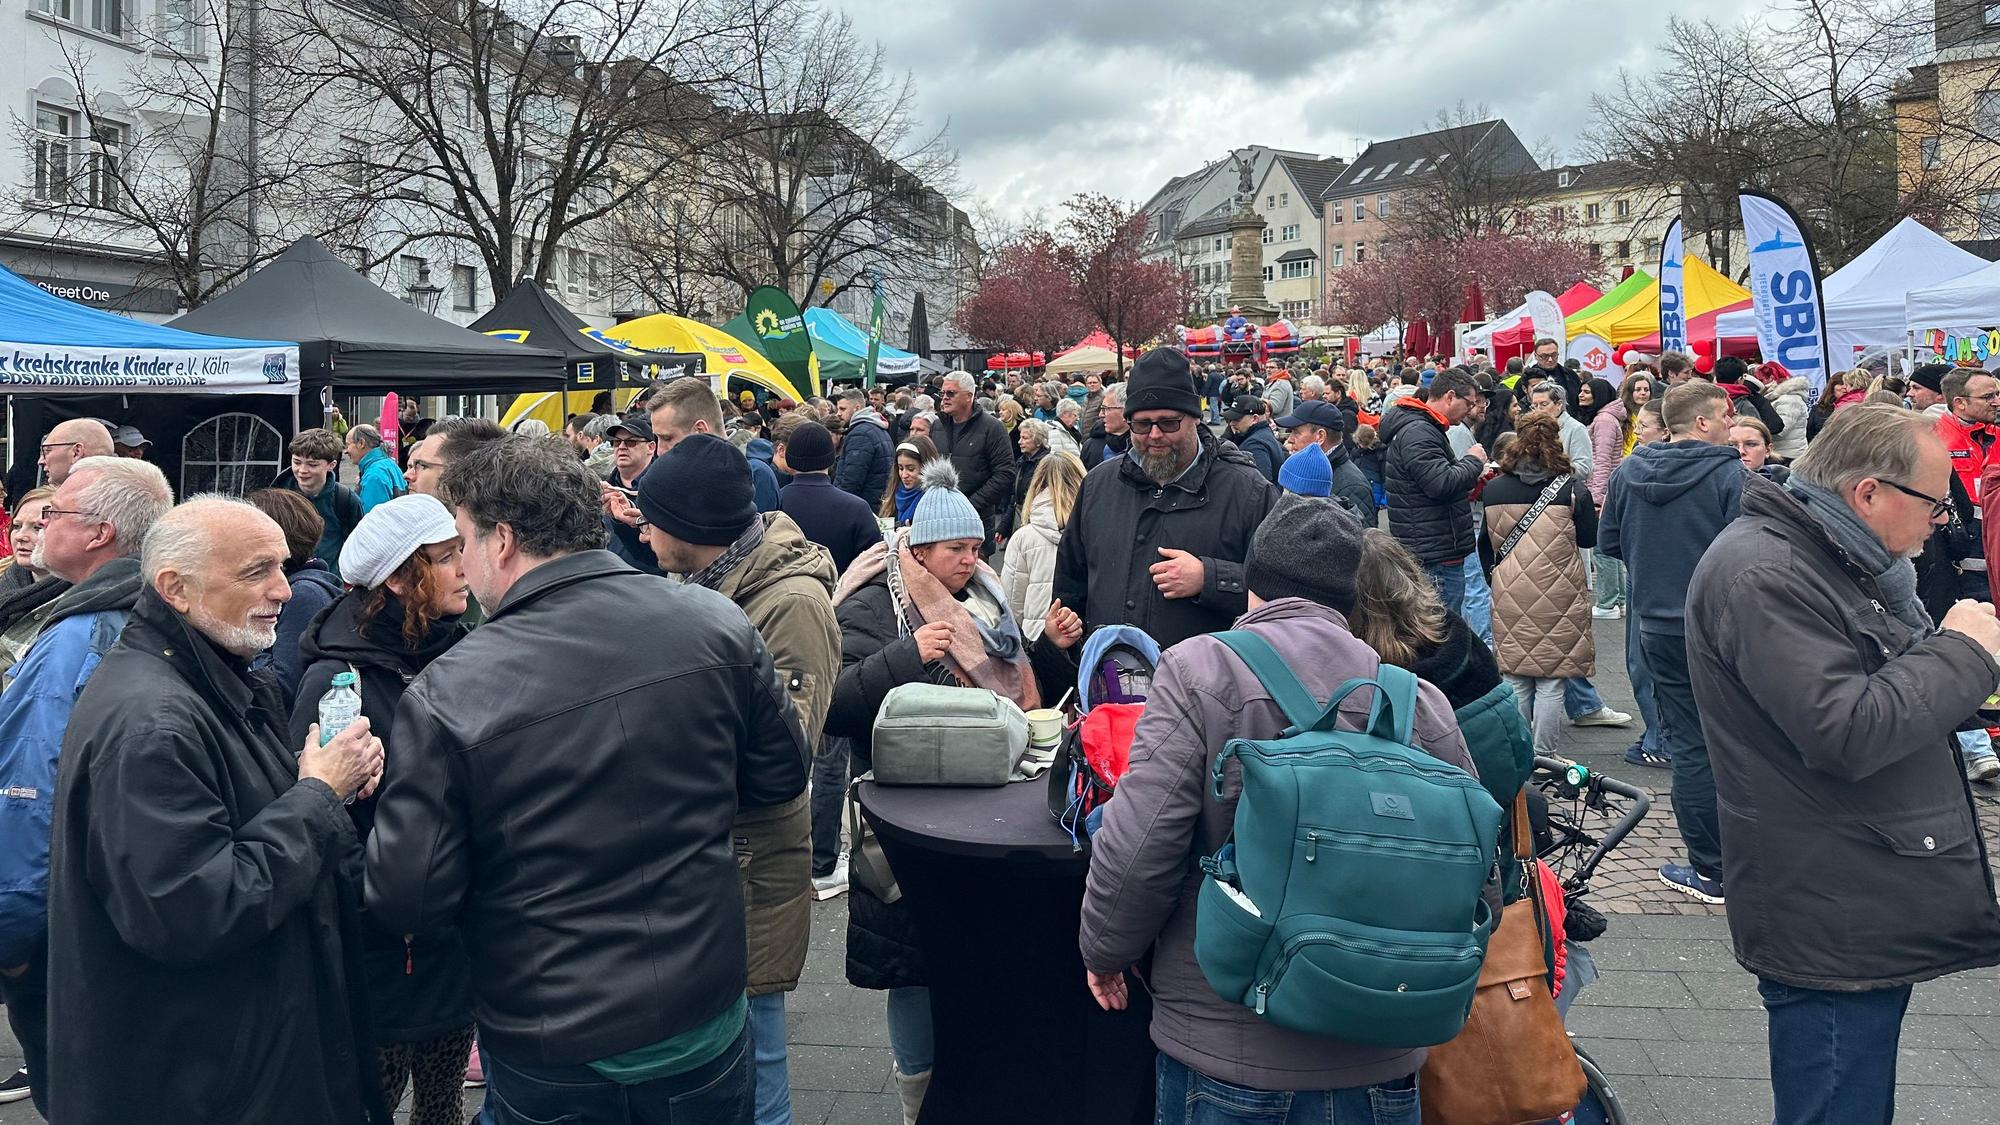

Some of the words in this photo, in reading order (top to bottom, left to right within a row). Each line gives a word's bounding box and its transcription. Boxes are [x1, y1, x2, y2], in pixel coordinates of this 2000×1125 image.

[37, 282, 81, 299] Street
[82, 286, 110, 301] One
[1770, 269, 1820, 371] SBU
[1924, 328, 1973, 362] TEAM
[1977, 329, 2000, 362] SO
[122, 355, 174, 376] Kinder
[175, 357, 198, 376] e.V.
[201, 355, 230, 375] Köln
